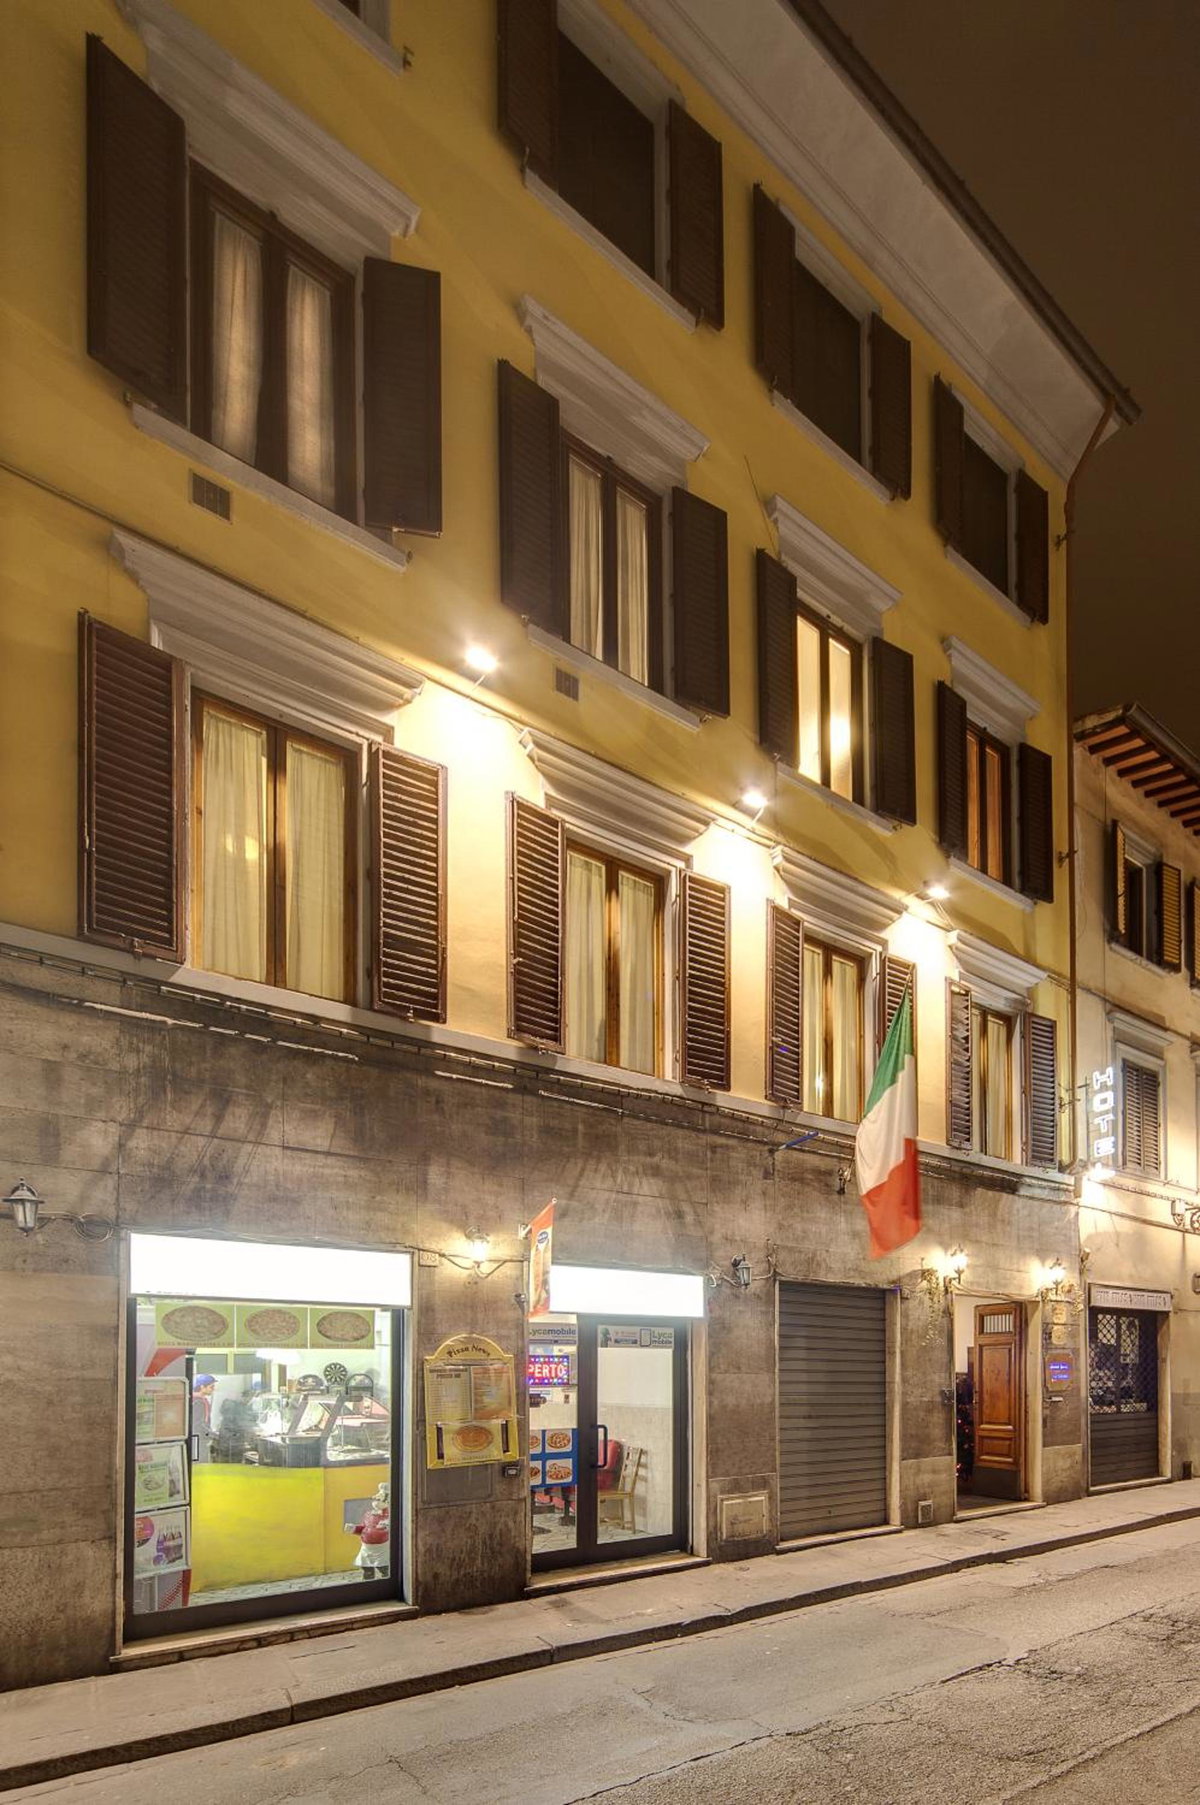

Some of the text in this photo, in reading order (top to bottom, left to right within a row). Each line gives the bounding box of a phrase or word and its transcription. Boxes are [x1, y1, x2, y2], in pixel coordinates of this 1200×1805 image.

[1093, 1067, 1115, 1179] HOTEL
[529, 1327, 576, 1337] ycamobile
[528, 1363, 565, 1378] PERTO
